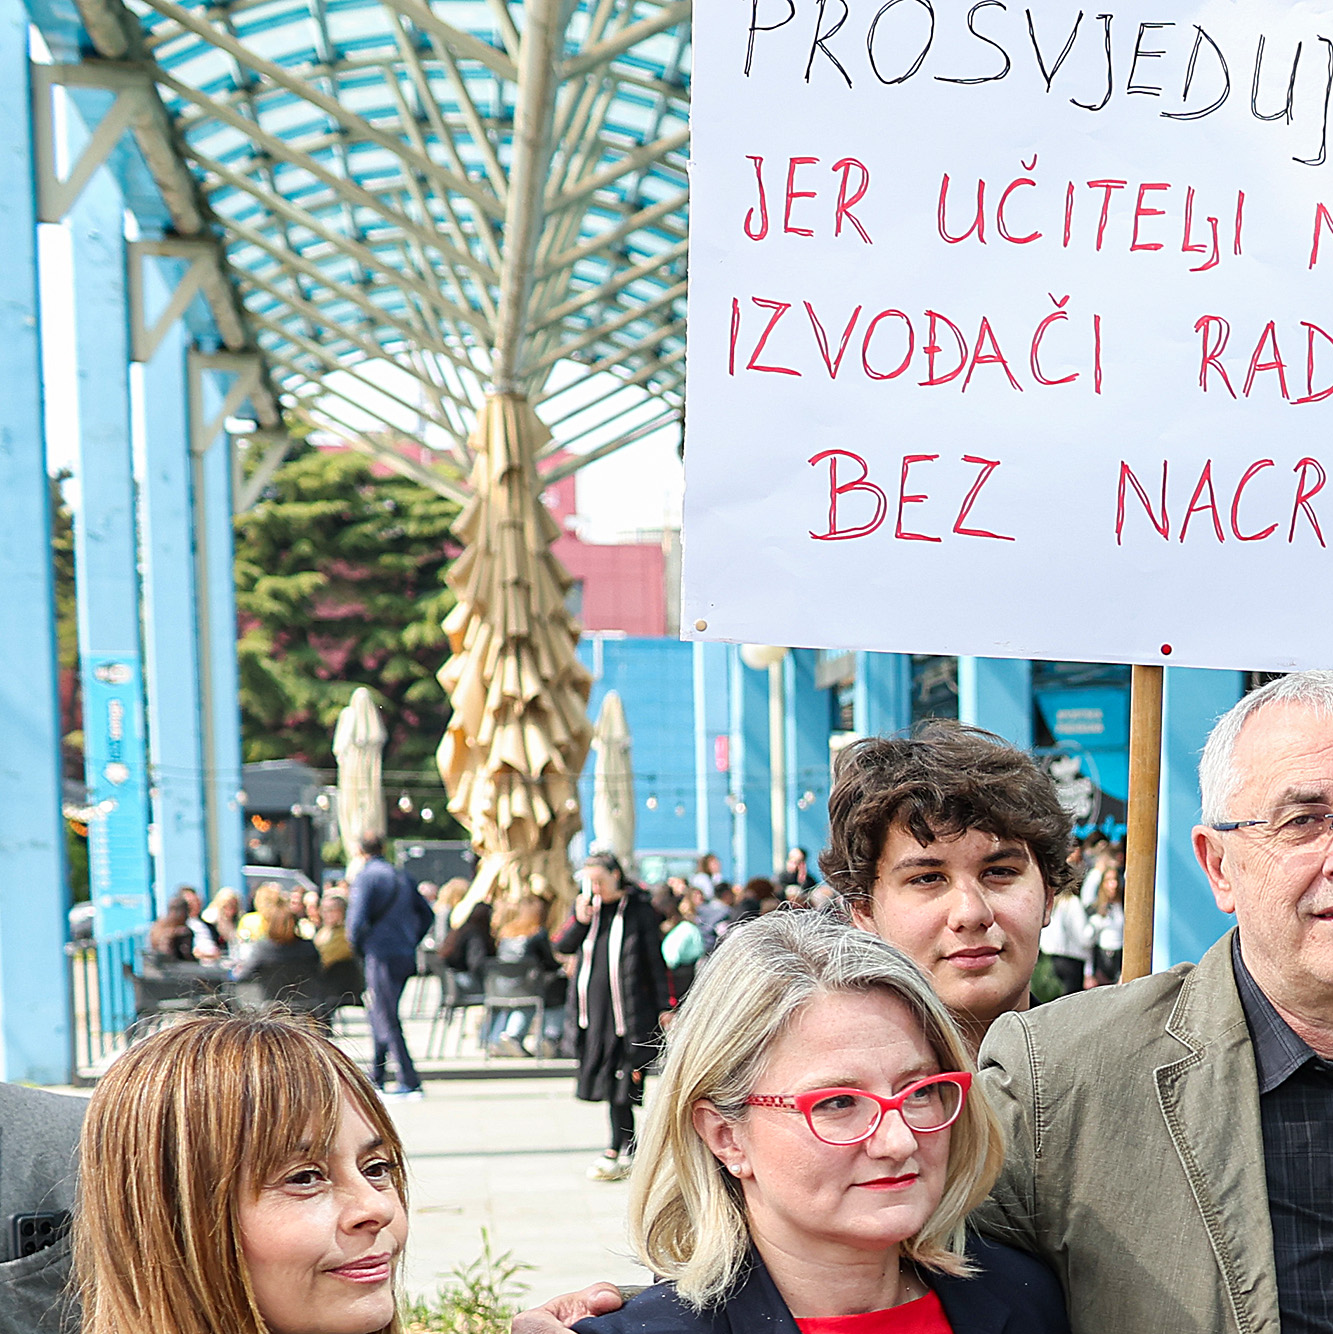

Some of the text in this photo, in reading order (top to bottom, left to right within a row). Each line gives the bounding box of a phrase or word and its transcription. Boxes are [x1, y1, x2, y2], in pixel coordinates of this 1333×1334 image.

[743, 155, 873, 245] JER
[937, 153, 1245, 273] UČITELJI
[728, 292, 1102, 395] IZVOĐAČI
[807, 449, 1016, 543] BEZ
